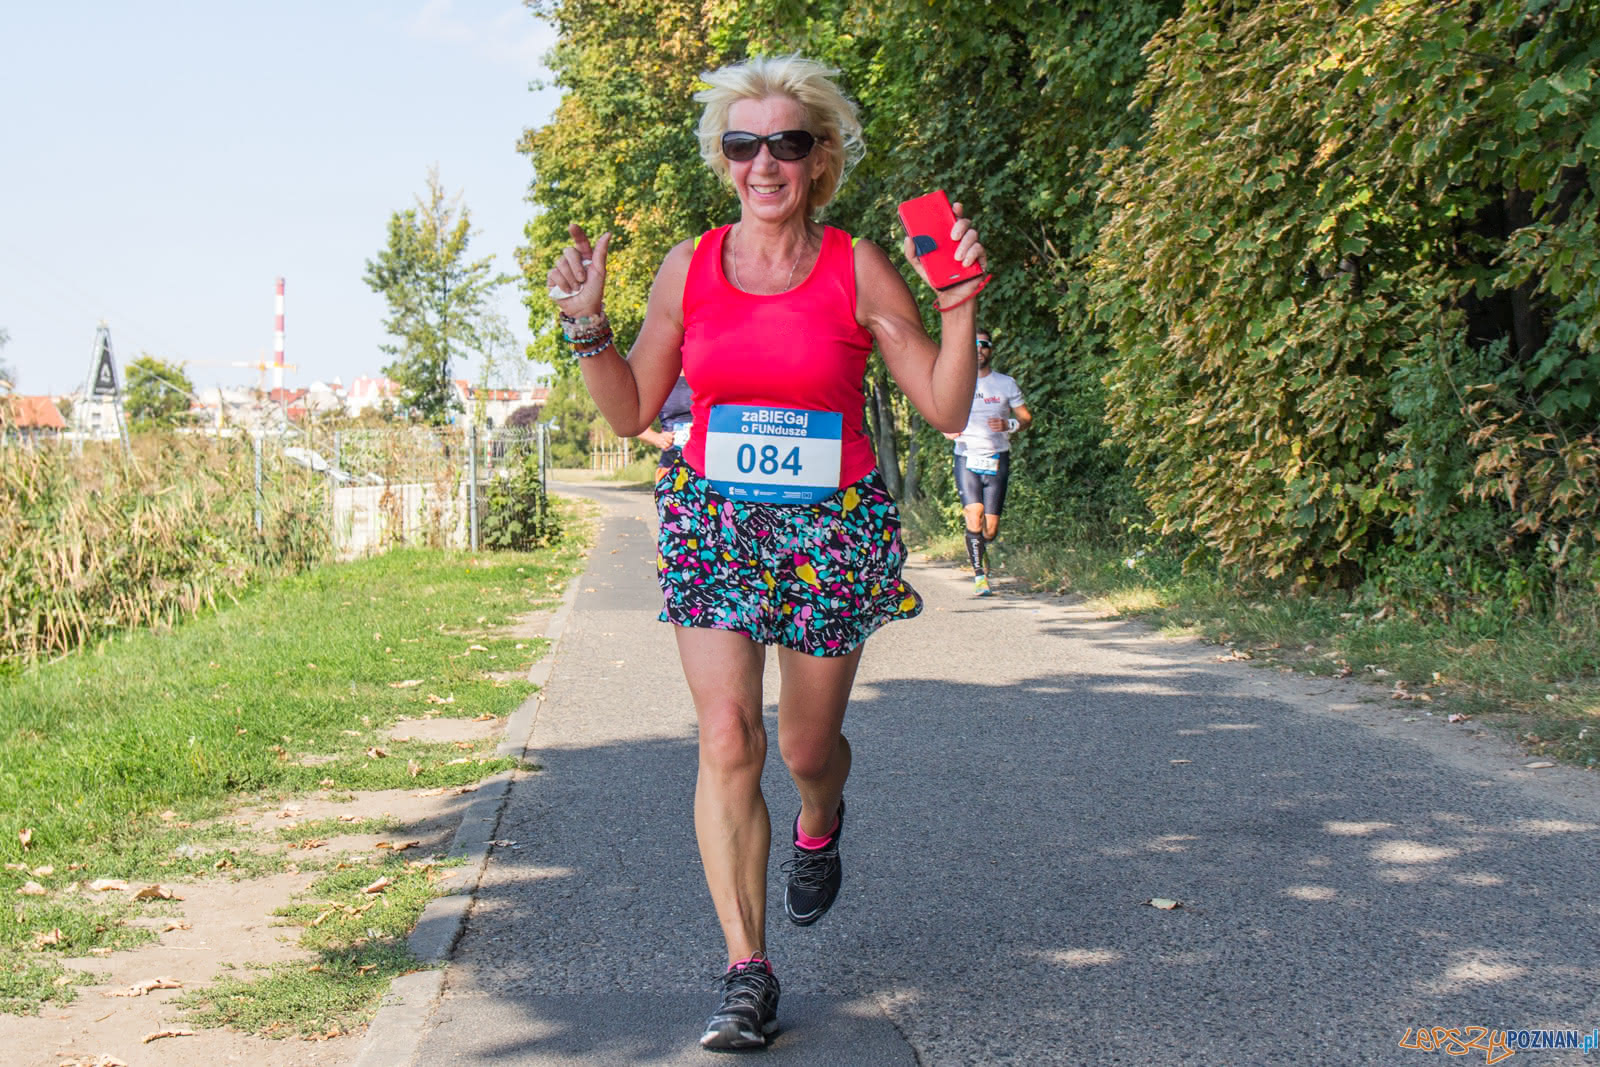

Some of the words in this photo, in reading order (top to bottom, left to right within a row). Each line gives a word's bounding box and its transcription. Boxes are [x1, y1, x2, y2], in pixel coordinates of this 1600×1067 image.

[741, 409, 809, 428] zaBIEGaj
[741, 425, 749, 433] o
[751, 423, 808, 437] FUNdusze
[736, 443, 803, 476] 084
